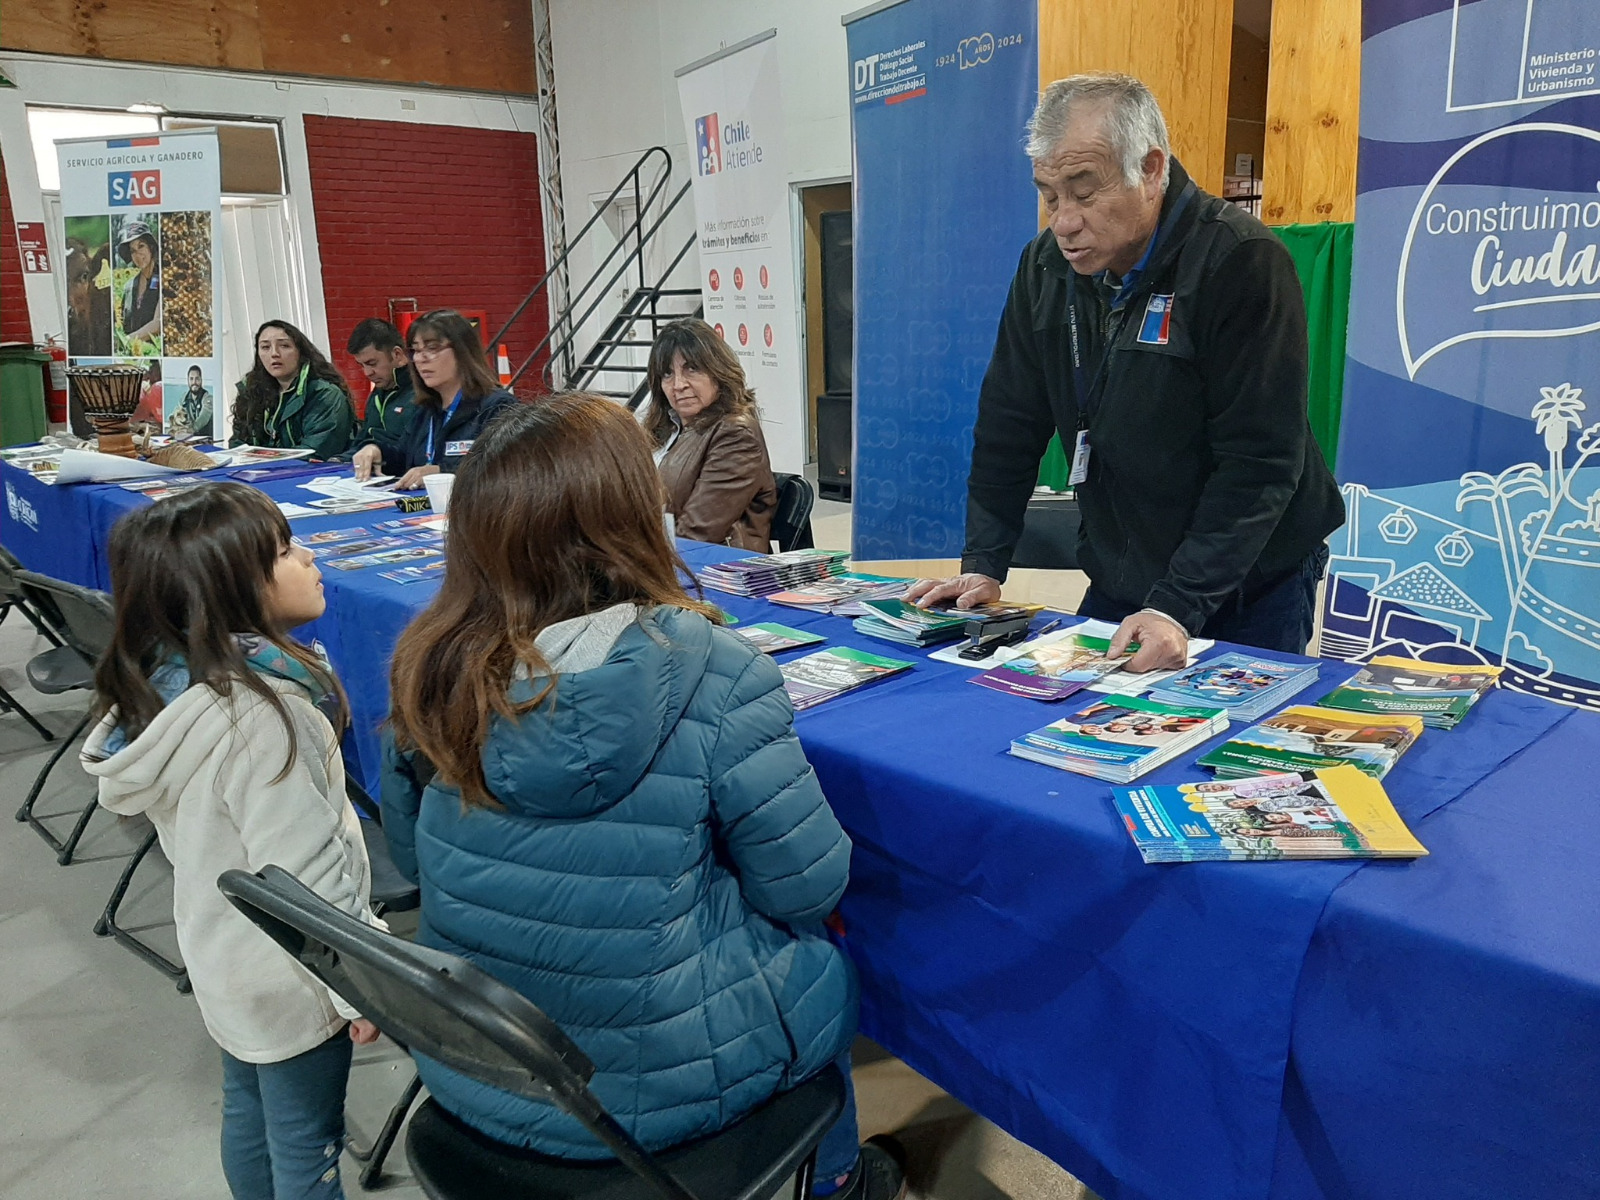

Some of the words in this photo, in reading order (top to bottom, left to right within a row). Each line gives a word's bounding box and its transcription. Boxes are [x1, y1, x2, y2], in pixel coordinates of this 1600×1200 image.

[880, 48, 901, 60] Derechos
[902, 41, 926, 54] Laborales
[935, 53, 956, 68] 1924
[998, 33, 1022, 48] 2024
[975, 43, 991, 55] AÑOS
[1530, 48, 1595, 67] Ministerio
[880, 61, 898, 72] Diálogo
[899, 54, 914, 66] Social
[1529, 63, 1583, 80] Vivienda
[1585, 63, 1595, 75] y
[855, 54, 879, 90] DT
[880, 70, 898, 81] Trabajo
[898, 65, 918, 77] Decente
[1528, 77, 1595, 92] Urbanismo
[724, 121, 750, 145] Chile
[67, 157, 104, 168] SERVICIO
[107, 154, 147, 165] AGRÍCOLA
[150, 155, 156, 163] Y
[158, 151, 204, 162] GANADERO
[726, 143, 763, 170] Atiende
[113, 176, 157, 200] SAG
[704, 221, 717, 233] Más
[702, 235, 725, 248] trámites
[726, 237, 730, 249] y
[730, 232, 760, 246] beneficios
[446, 442, 458, 450] IPS
